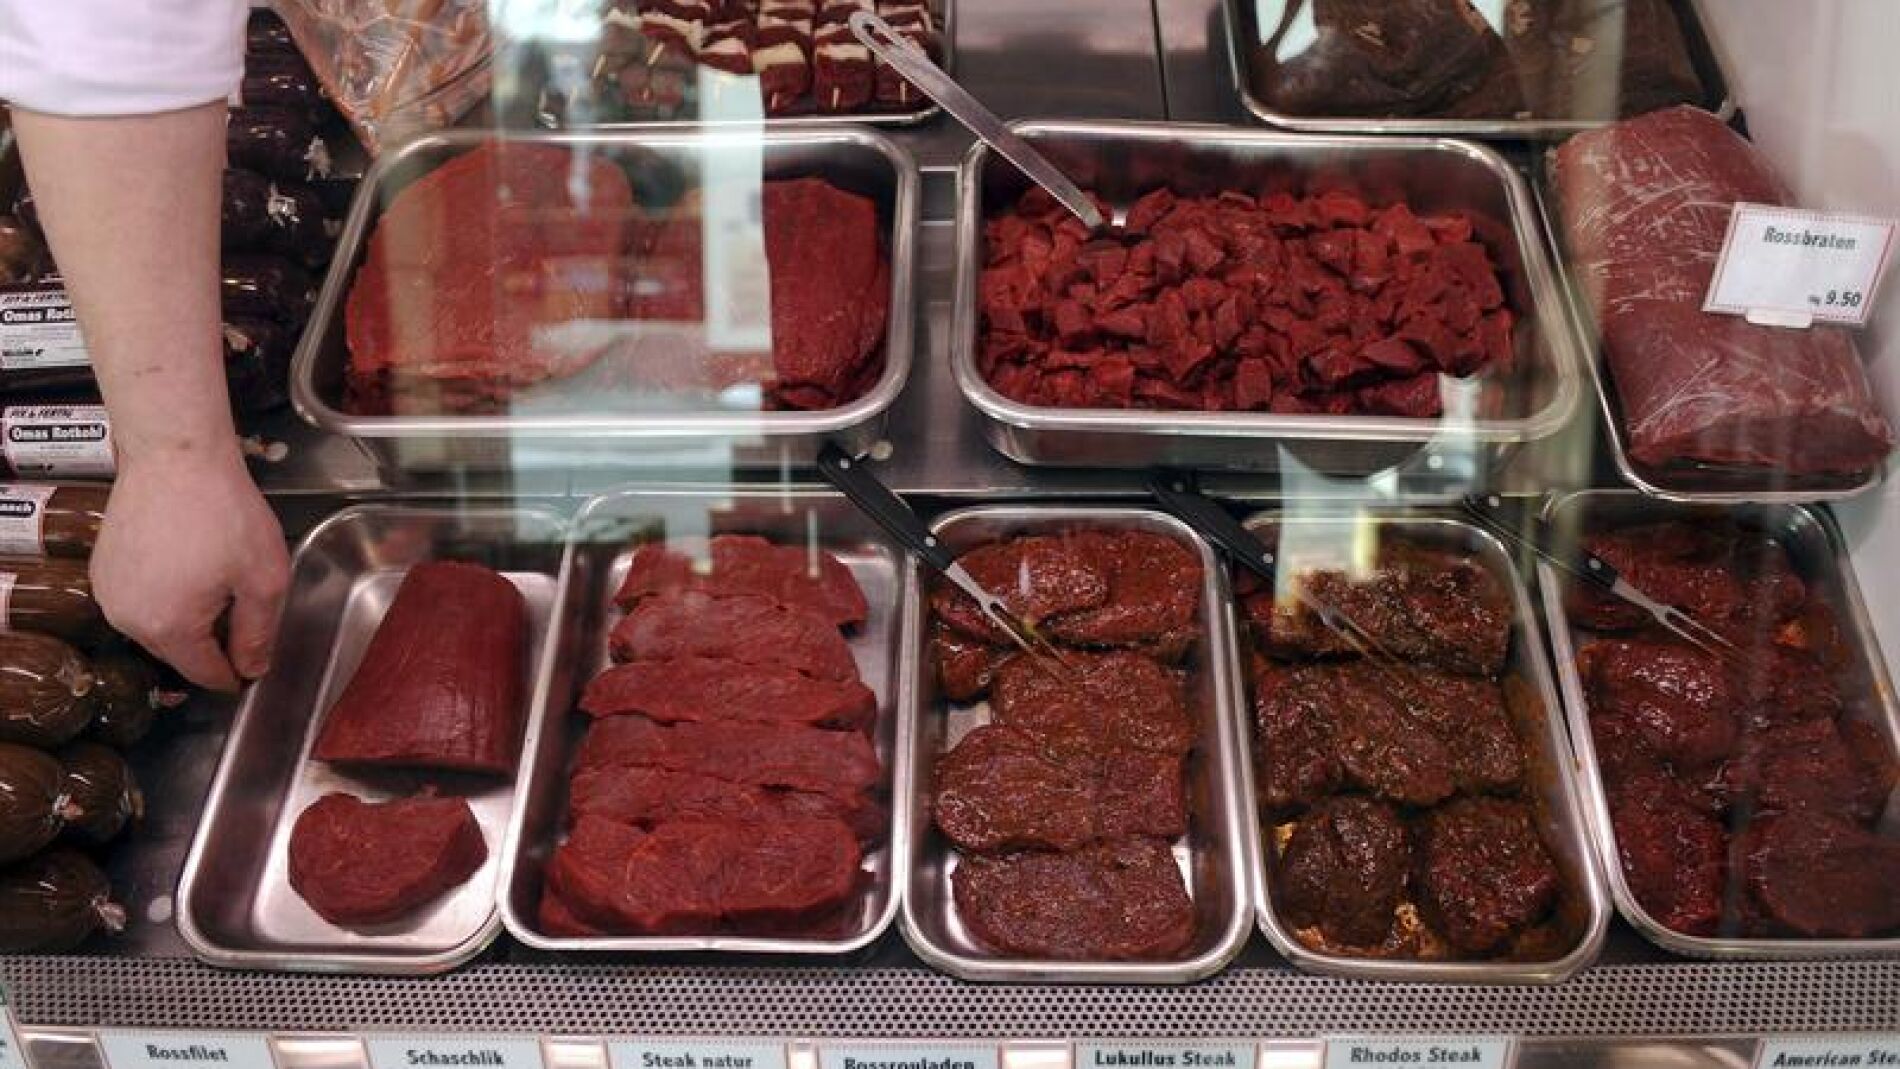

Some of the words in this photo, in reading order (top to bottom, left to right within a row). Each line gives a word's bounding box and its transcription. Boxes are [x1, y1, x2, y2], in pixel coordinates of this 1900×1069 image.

[1763, 225, 1856, 249] Rossbraten
[1826, 289, 1862, 307] 9.50
[3, 310, 42, 322] Omas
[12, 426, 49, 440] Omas
[51, 424, 103, 439] Rotkohl
[147, 1044, 228, 1062] Rossfilet
[406, 1049, 504, 1065] Schaschlik
[642, 1052, 697, 1068] Steak
[702, 1054, 753, 1068] natur
[1094, 1050, 1176, 1067] Lukullus
[1182, 1050, 1236, 1067] Steak
[1350, 1046, 1421, 1063] Rhodos
[1427, 1046, 1482, 1063] Steak
[1773, 1050, 1862, 1067] American
[1867, 1049, 1900, 1066] Ste
[843, 1057, 975, 1069] Rossrouladen
